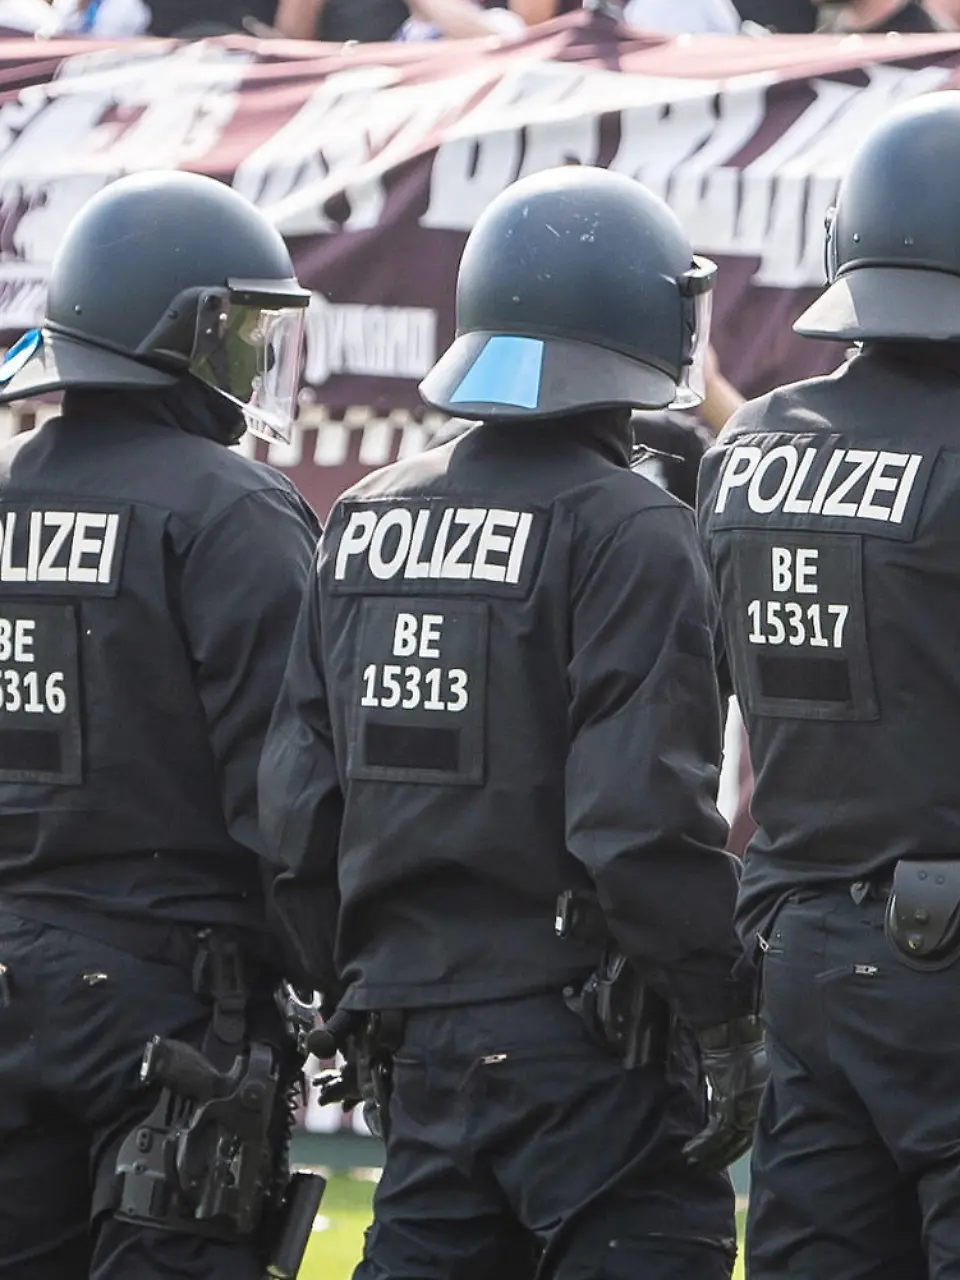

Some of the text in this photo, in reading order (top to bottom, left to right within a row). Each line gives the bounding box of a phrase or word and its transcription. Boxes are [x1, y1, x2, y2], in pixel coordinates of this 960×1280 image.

[714, 446, 923, 523] POLIZEI
[0, 511, 119, 583] LIZEI
[335, 507, 533, 583] POLIZEI
[772, 547, 818, 593] BE
[393, 613, 443, 658] BE
[747, 600, 849, 648] 15317
[0, 669, 66, 713] 316
[361, 664, 468, 711] 15313
